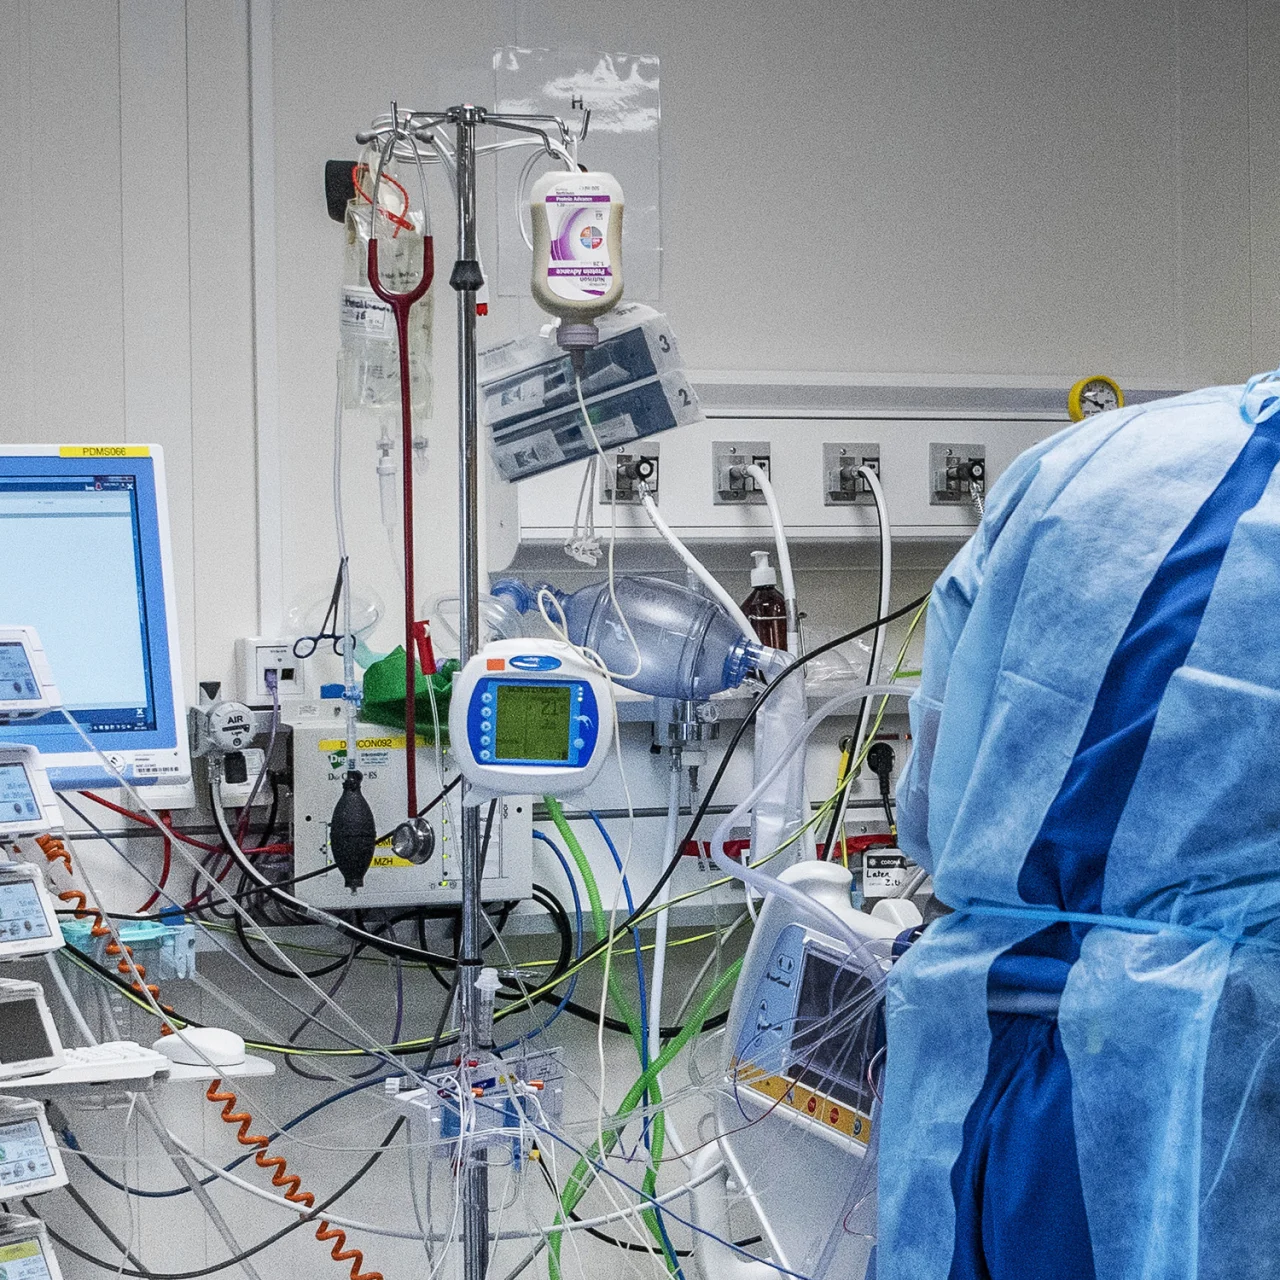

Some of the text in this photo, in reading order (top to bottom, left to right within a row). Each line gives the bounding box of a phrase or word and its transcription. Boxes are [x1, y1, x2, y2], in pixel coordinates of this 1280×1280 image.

[556, 268, 580, 276] Advance
[659, 334, 671, 354] 3
[678, 388, 692, 407] 2
[227, 715, 244, 724] AIR
[373, 858, 393, 866] MZH
